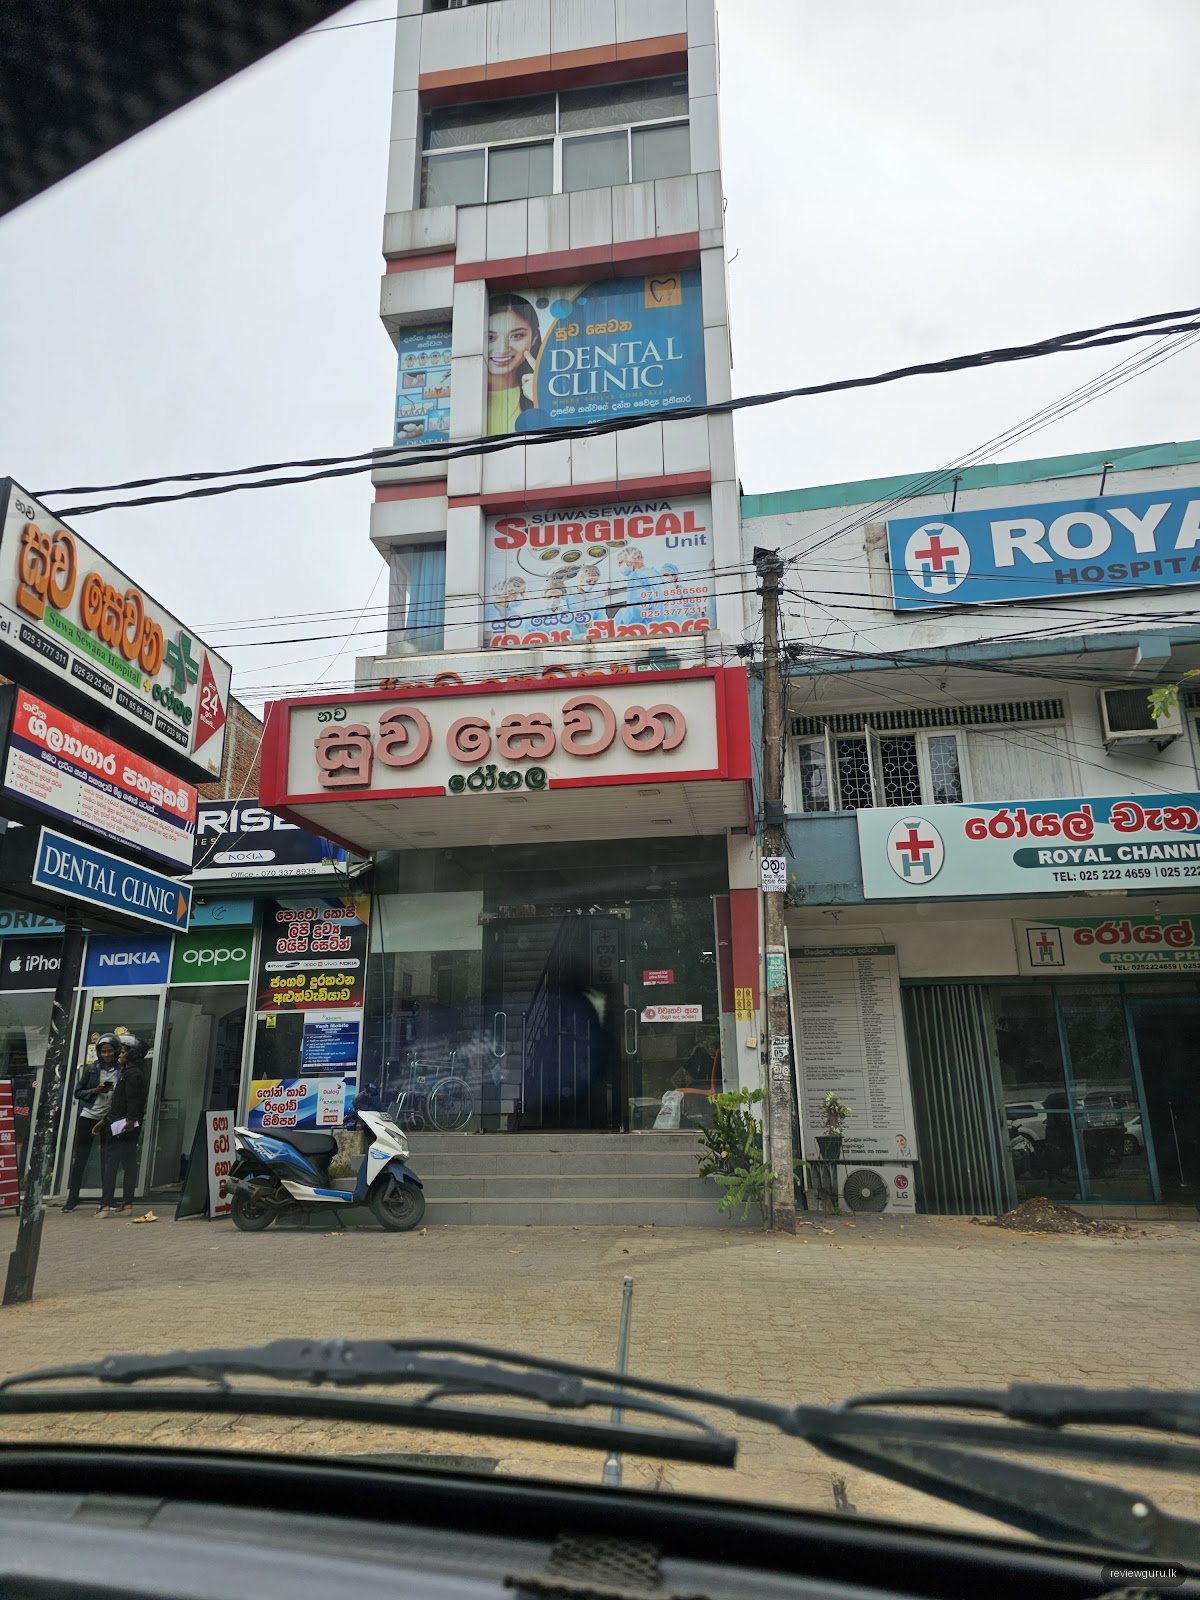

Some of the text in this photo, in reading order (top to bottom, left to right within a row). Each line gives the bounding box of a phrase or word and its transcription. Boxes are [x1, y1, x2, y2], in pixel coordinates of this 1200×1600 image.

[586, 319, 633, 335] සෙවන
[549, 337, 683, 372] DENTAL
[548, 364, 663, 397] CLINIC
[15, 499, 35, 520] නව
[532, 501, 672, 524] SUWASEWANA
[494, 510, 706, 550] SURGICAL
[665, 534, 707, 549] Unit
[16, 522, 164, 676] සුව සෙවන
[663, 586, 708, 596] 8586560
[531, 610, 592, 627] සෙවන
[641, 606, 707, 618] 025 3777311
[0, 615, 11, 633] el
[22, 630, 67, 664] 025 3 777 311
[49, 612, 139, 682] Suwa Sewana Hospital
[73, 664, 113, 695] 025 22 25 400
[118, 693, 129, 706] 071
[152, 684, 193, 726] රෝහල
[201, 686, 218, 716] 24
[317, 707, 347, 722] නව
[314, 695, 687, 788] සුව සෙවන
[448, 764, 548, 793] රෝහල
[965, 804, 1095, 842] රෝයල්
[228, 852, 264, 861] NOKIA
[1038, 847, 1111, 865] ROYAL
[42, 845, 175, 916] DENTAL CLINIC
[1053, 871, 1077, 882] TEL:
[1079, 870, 1099, 881] 025
[1102, 869, 1122, 880] 222
[1125, 868, 1151, 879] 4659
[1160, 866, 1181, 878] 025
[1183, 865, 1200, 877] 222
[289, 922, 309, 938] ලිපි
[1074, 920, 1194, 948] රෝයල්
[25, 954, 61, 971] iPho
[99, 951, 161, 966] NOKIA
[182, 947, 247, 966] oppo
[1110, 952, 1169, 962] ROYAL
